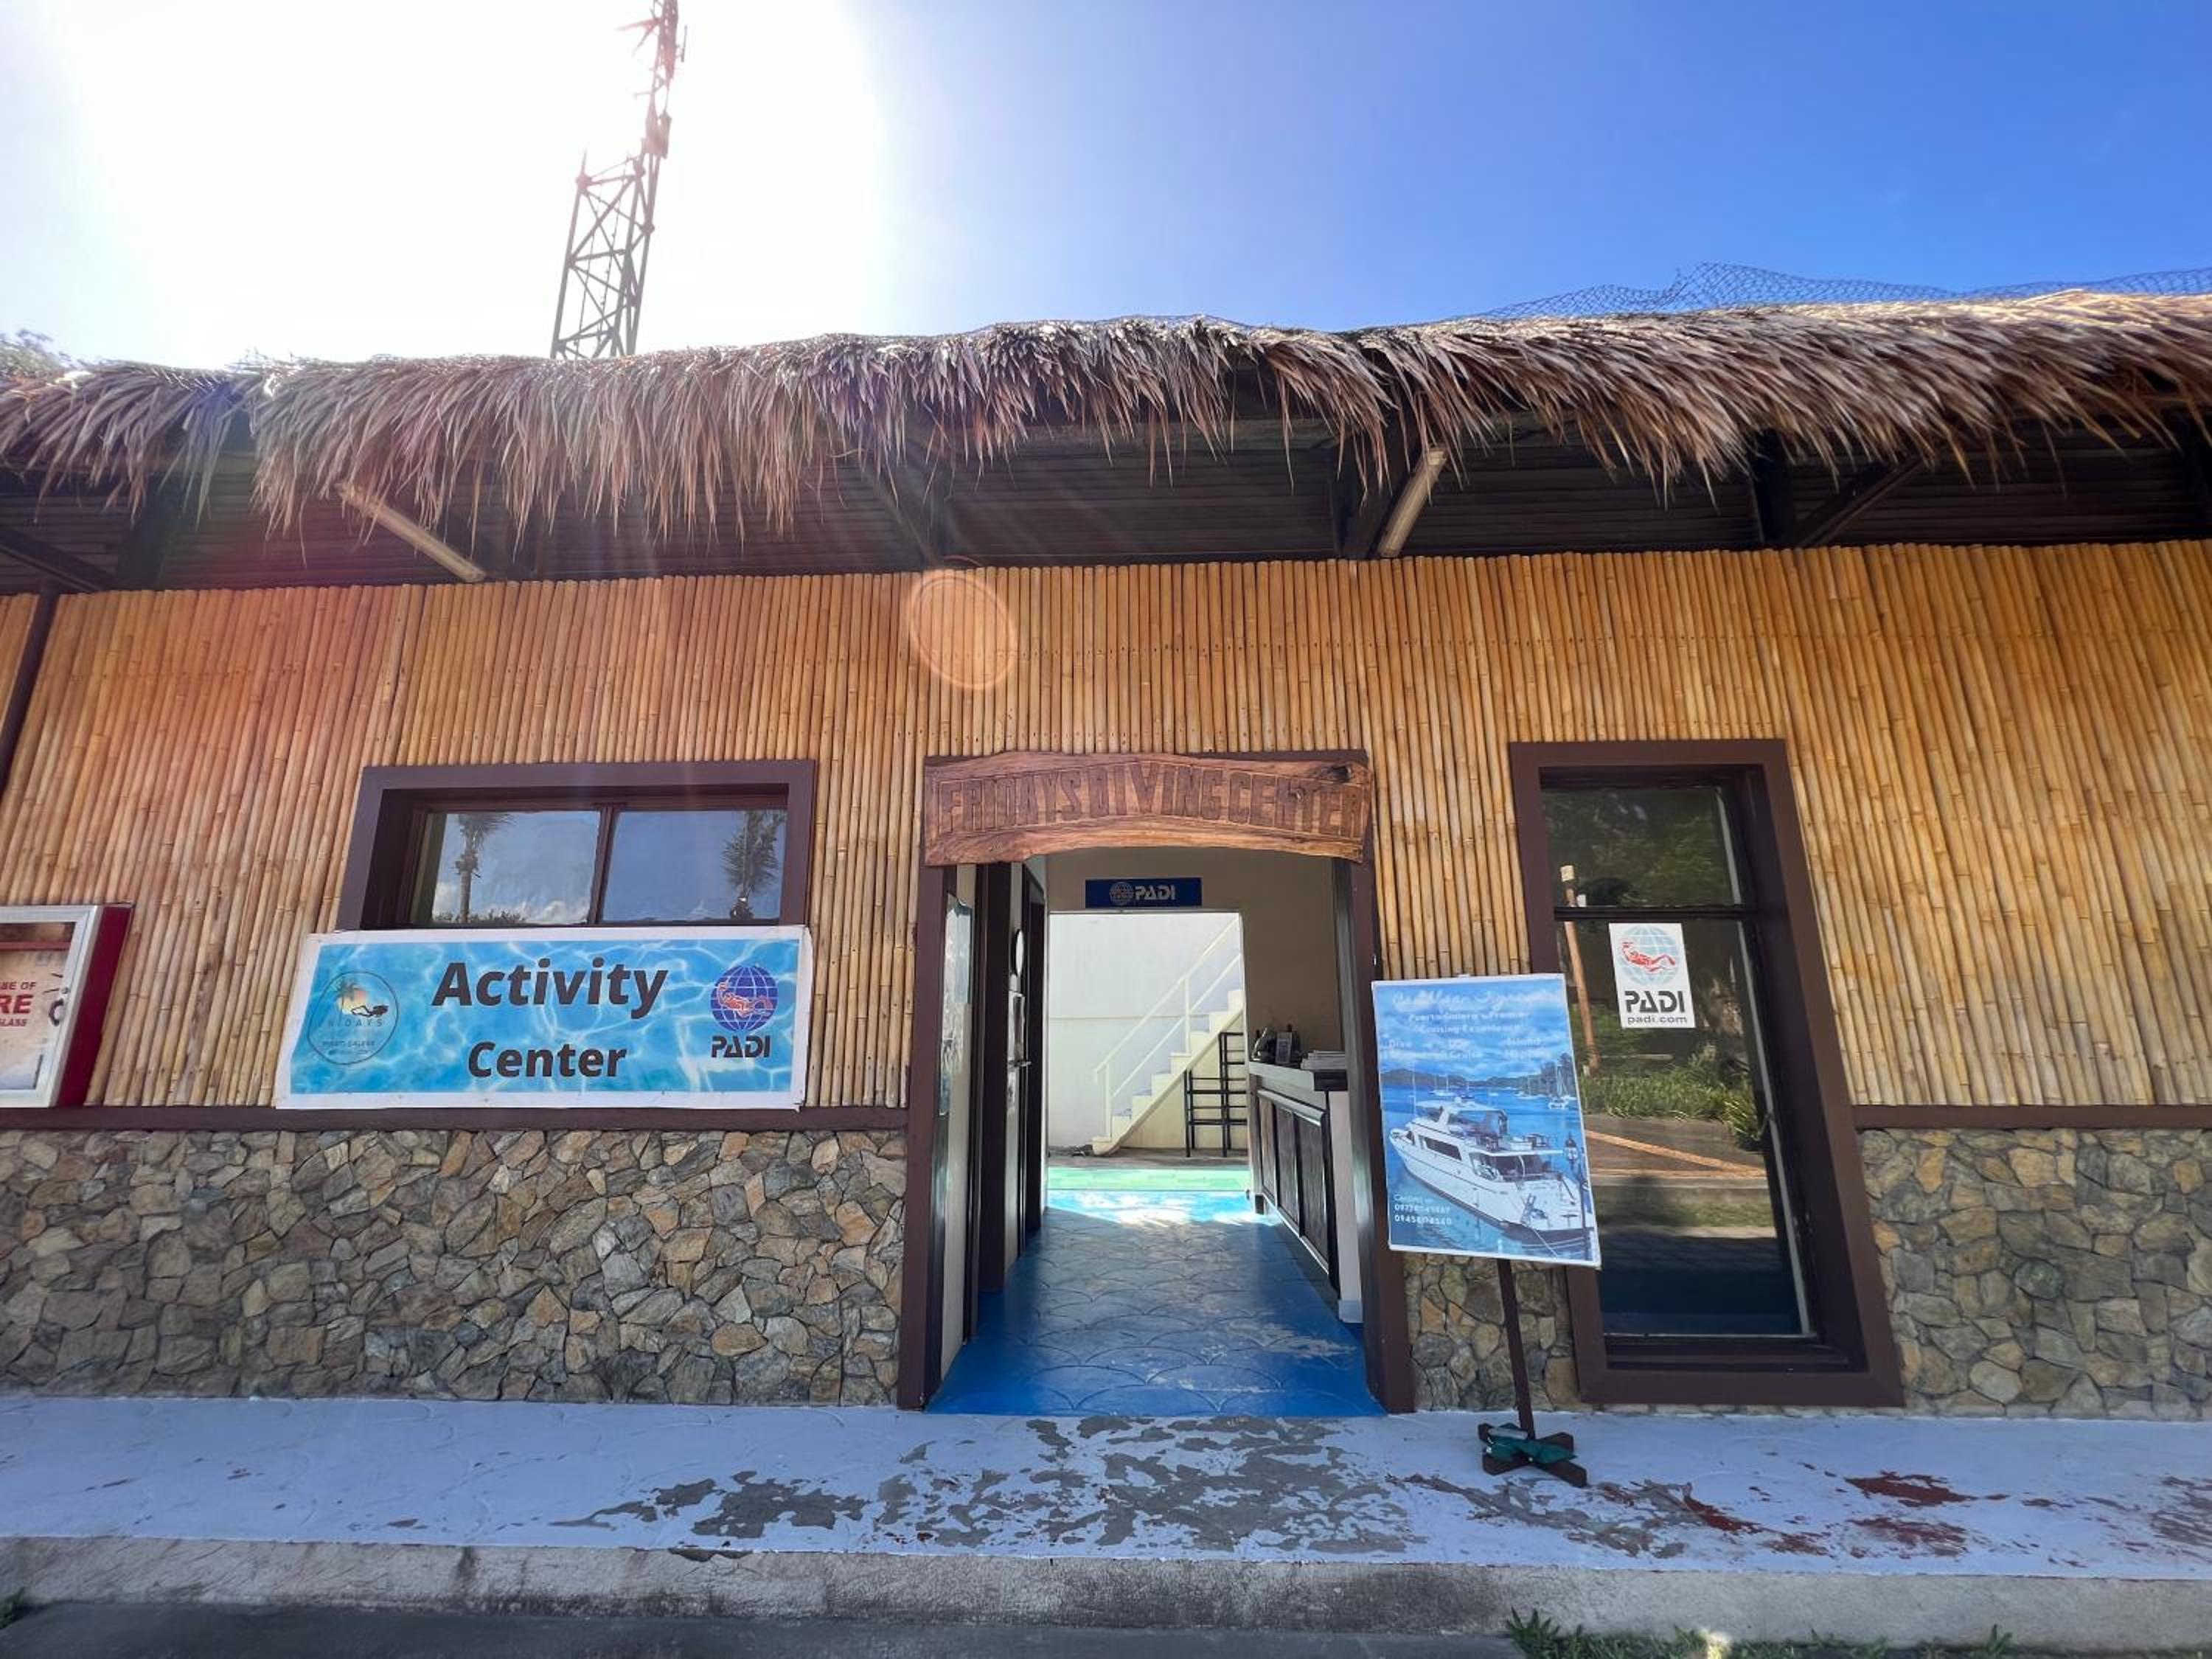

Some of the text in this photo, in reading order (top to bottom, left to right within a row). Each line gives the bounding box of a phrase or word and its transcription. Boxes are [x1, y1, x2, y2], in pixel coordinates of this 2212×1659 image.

[939, 770, 1082, 834] FRIDAYS
[1088, 760, 1224, 820] DIVING
[1135, 885, 1176, 900] PADI
[431, 958, 668, 1020] Activity
[1624, 990, 1686, 1013] PADI
[1627, 1016, 1688, 1025] padi.com
[711, 1035, 771, 1058] PADI
[468, 1041, 627, 1078] Center
